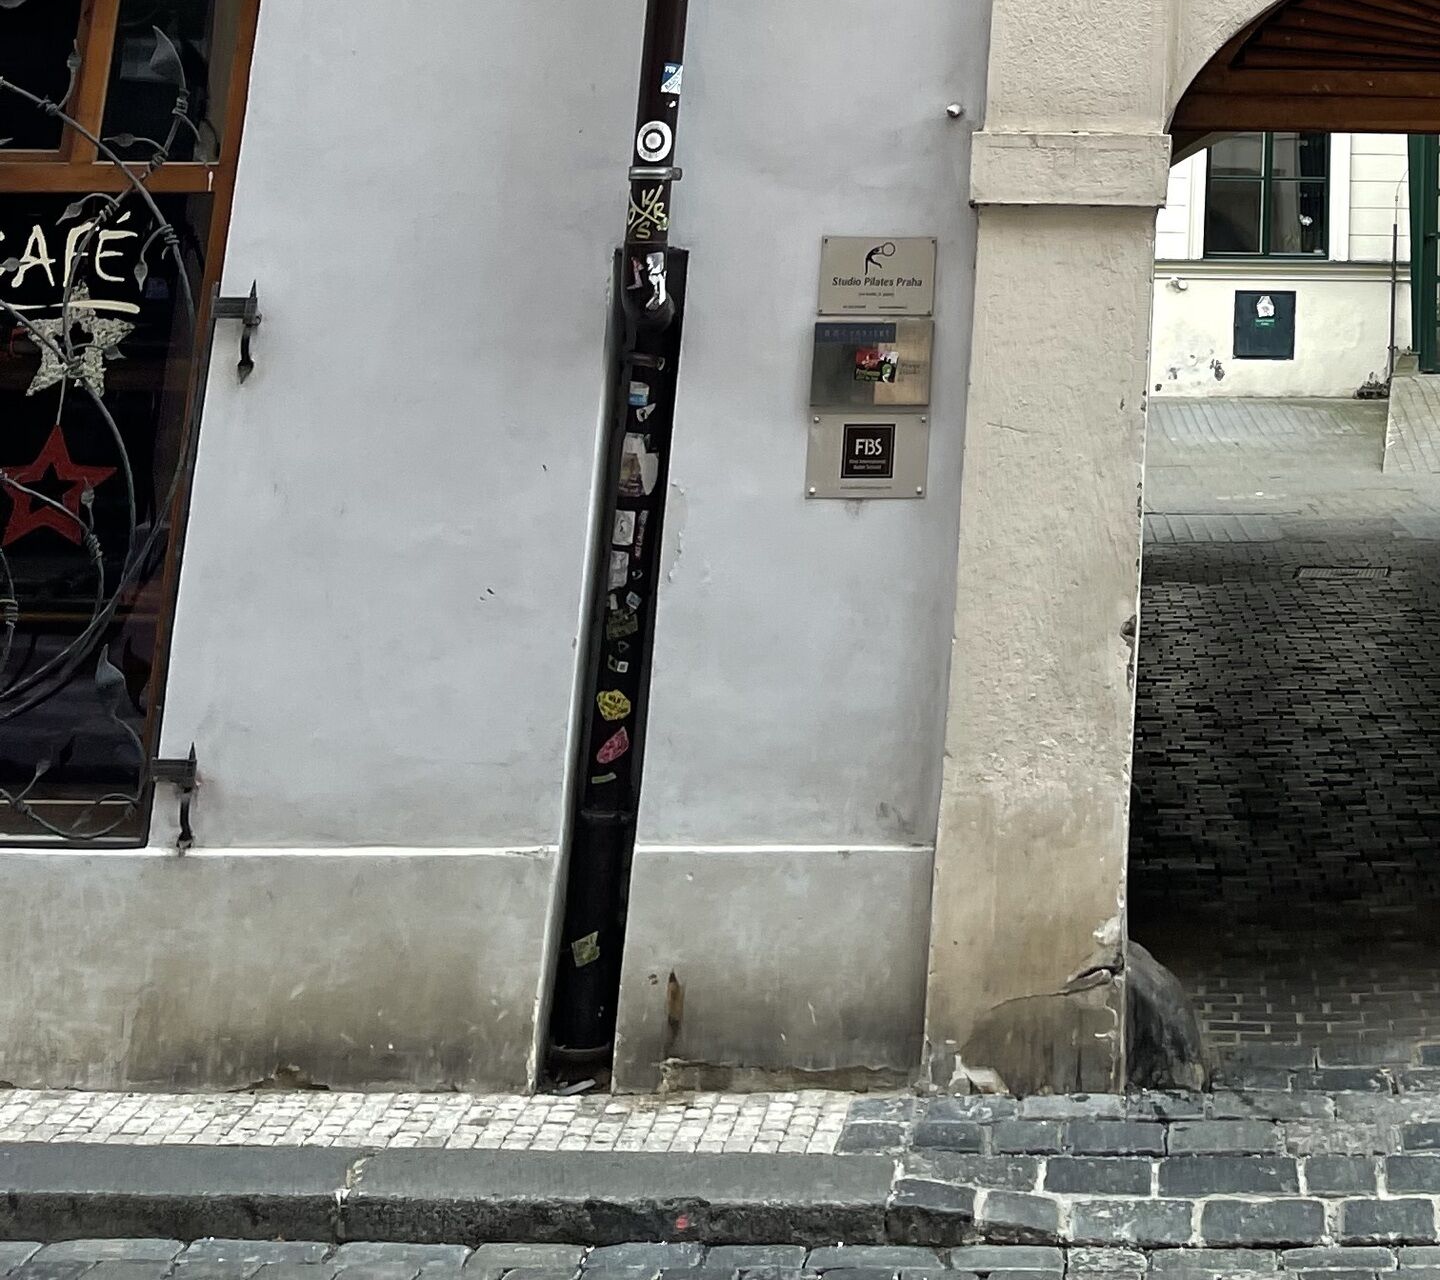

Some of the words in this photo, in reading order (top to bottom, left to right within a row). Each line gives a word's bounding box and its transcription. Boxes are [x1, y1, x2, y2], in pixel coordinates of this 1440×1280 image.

[0, 211, 138, 288] AFÉ
[832, 276, 862, 287] Studio
[863, 277, 894, 287] Pilates
[896, 277, 923, 288] Praha
[855, 438, 882, 455] FBS
